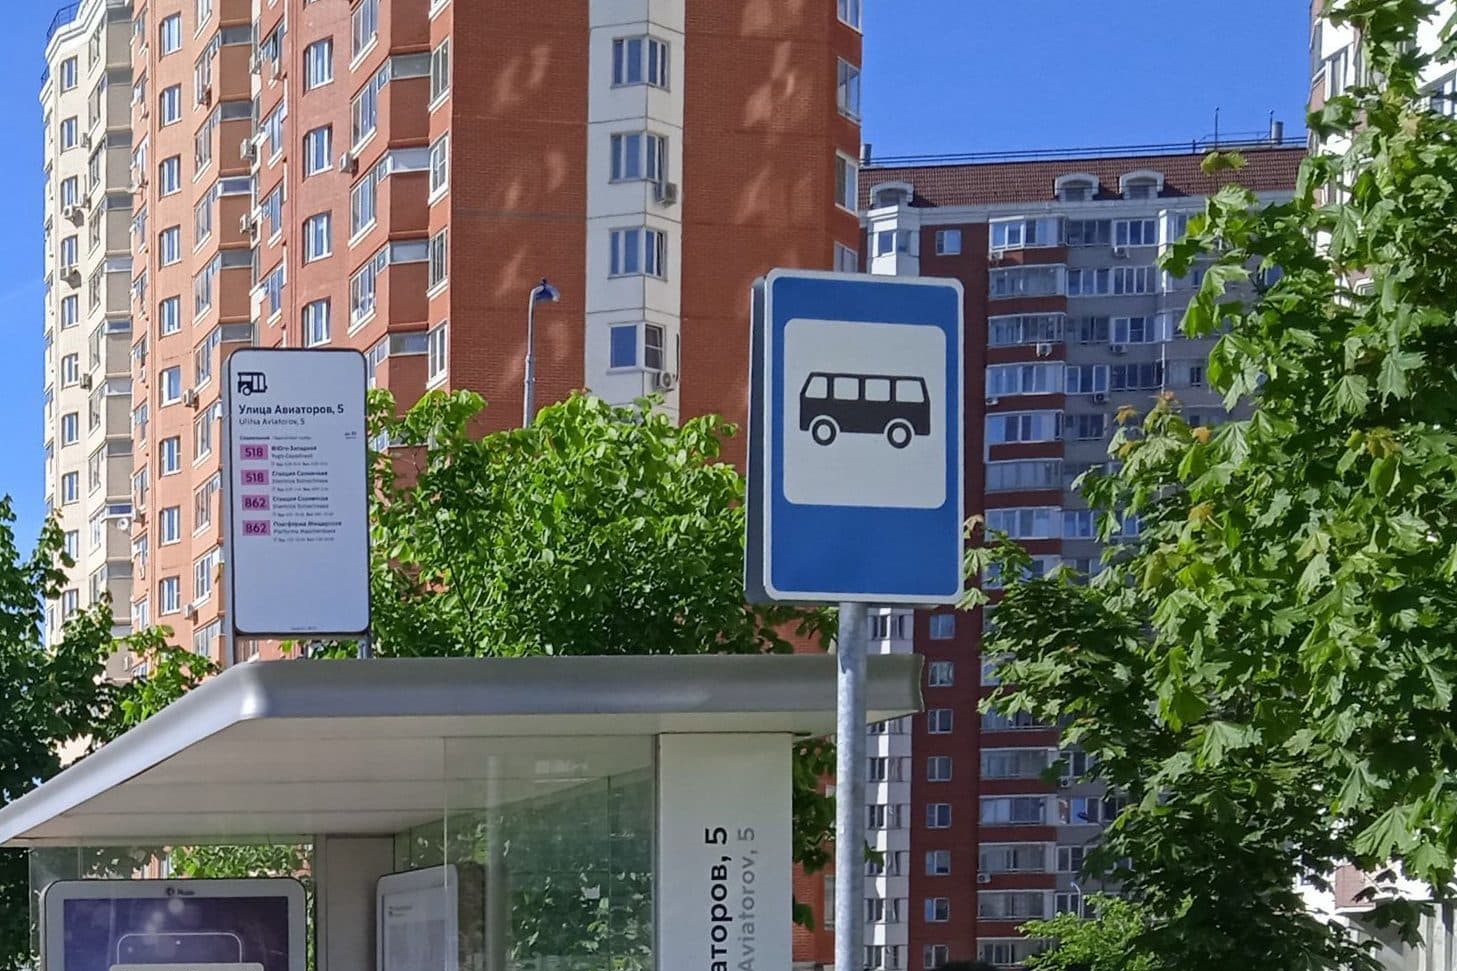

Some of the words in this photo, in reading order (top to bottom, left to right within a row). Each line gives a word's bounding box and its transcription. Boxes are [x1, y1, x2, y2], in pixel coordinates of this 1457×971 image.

[239, 404, 272, 415] Улица
[275, 404, 335, 416] Авиаторов,
[337, 404, 344, 414] 5
[245, 447, 263, 457] 518
[246, 472, 264, 483] 518
[705, 826, 728, 845] 5
[737, 826, 756, 842] 5
